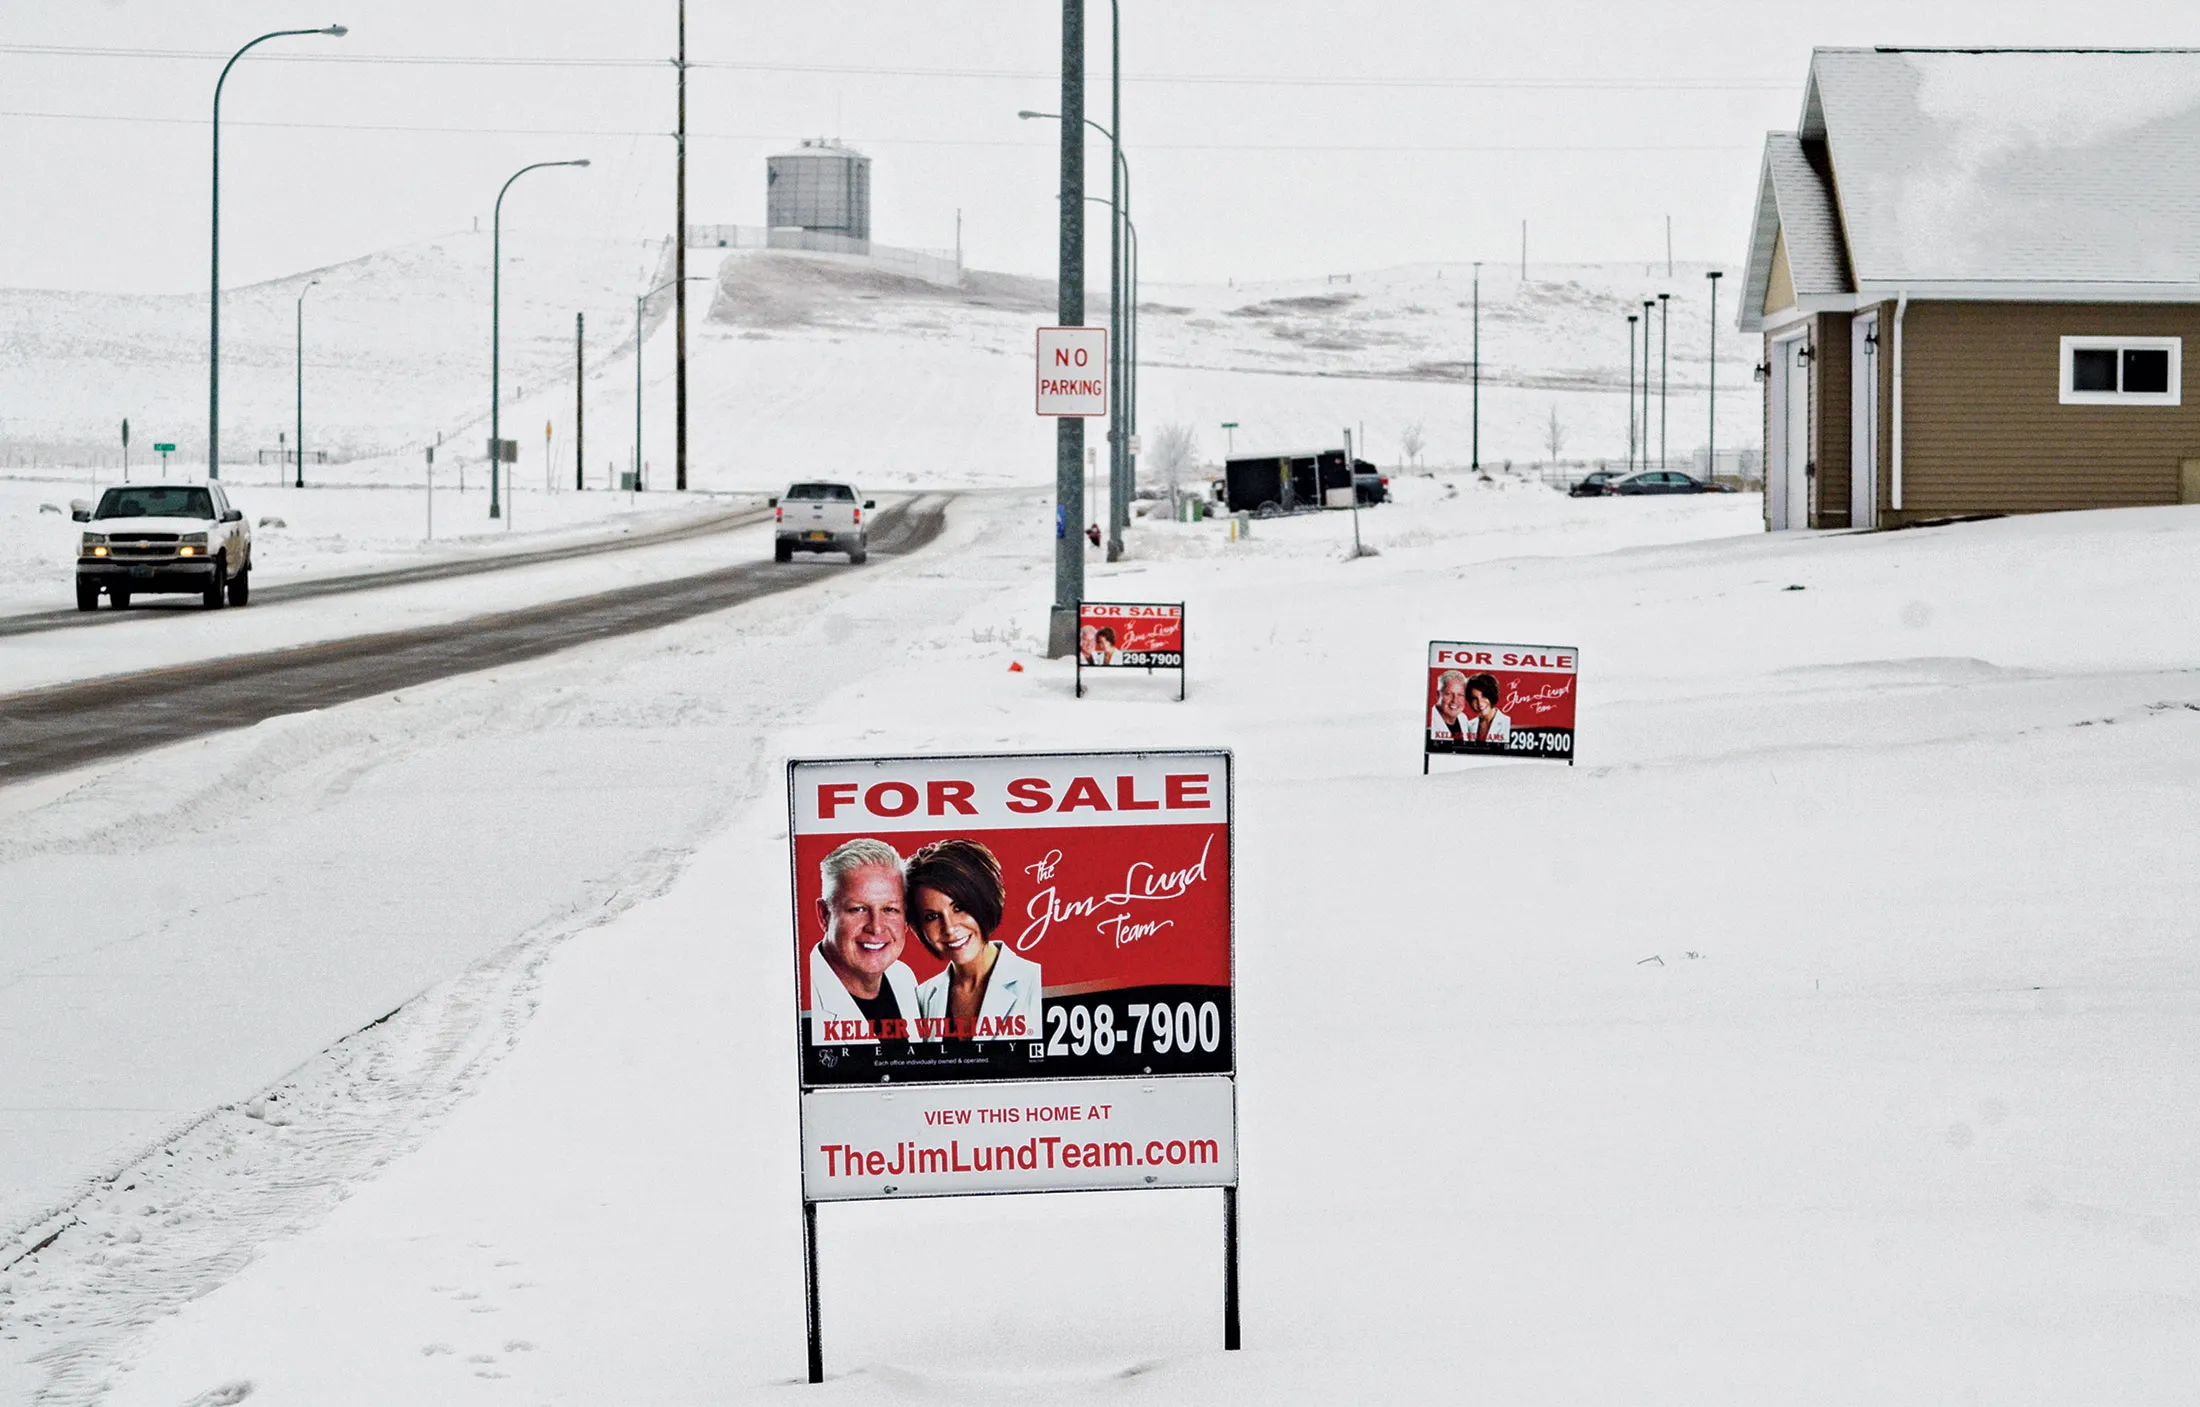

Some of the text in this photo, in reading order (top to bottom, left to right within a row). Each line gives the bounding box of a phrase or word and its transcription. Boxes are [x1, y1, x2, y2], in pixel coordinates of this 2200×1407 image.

[1055, 348, 1088, 367] NO
[1040, 379, 1102, 396] PARKING
[1081, 606, 1181, 617] FOR SALE
[1123, 652, 1181, 665] 298-7900
[1438, 650, 1573, 669] FOR SALE
[1435, 730, 1464, 740] KEL
[1511, 731, 1571, 752] 298-7900
[817, 773, 1211, 819] FOR SALE
[1025, 849, 1062, 884] The
[1016, 833, 1214, 951] Jim Lund
[1097, 912, 1174, 949] Team
[824, 1018, 908, 1041] KELLER
[1046, 1001, 1221, 1056] 298-7900
[924, 1104, 1113, 1126] VIEW THIS HOME AT
[820, 1136, 1219, 1178] TheJimLundTeam.com
